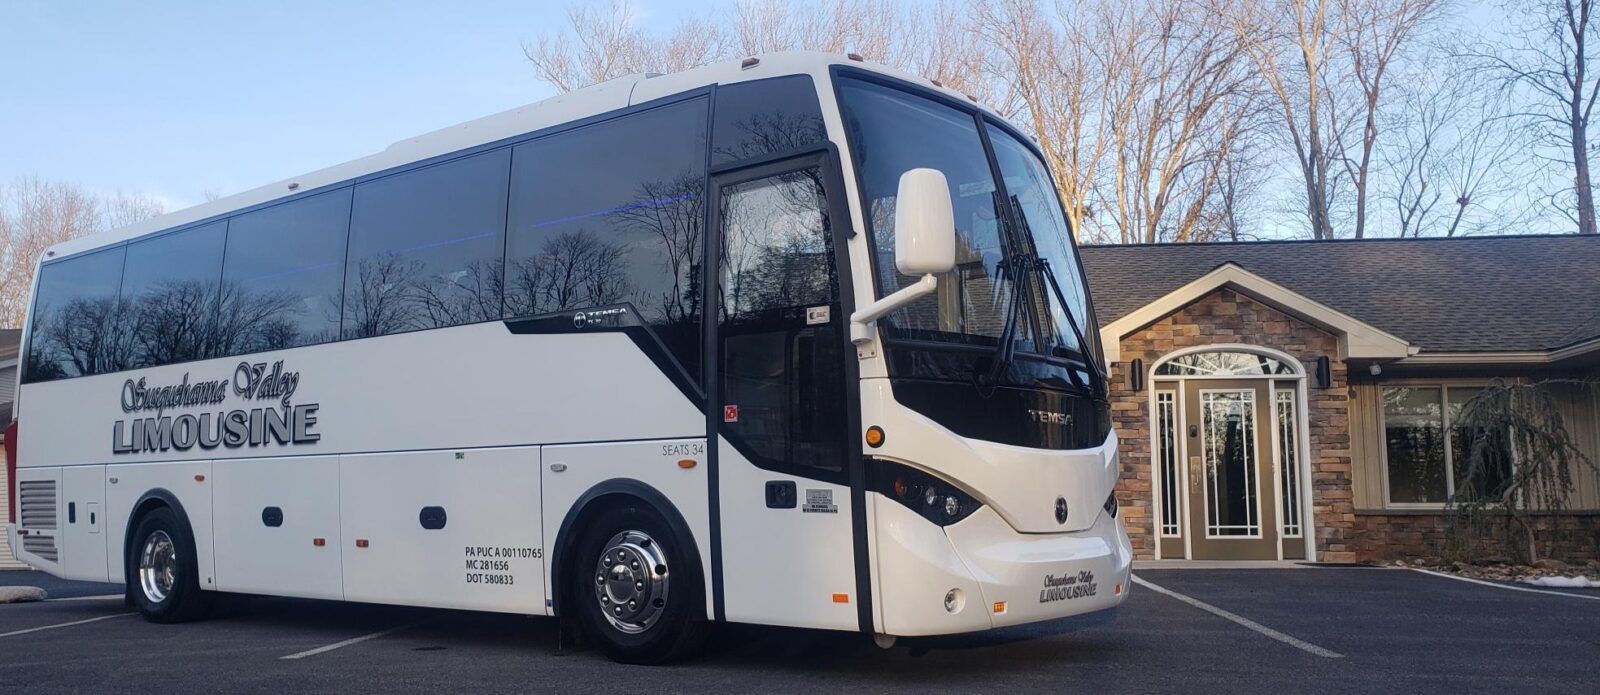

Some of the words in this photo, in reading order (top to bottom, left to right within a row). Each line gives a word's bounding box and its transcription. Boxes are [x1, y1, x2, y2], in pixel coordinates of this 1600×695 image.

[120, 372, 229, 418] Susquehanna
[233, 359, 300, 407] Valley
[1028, 409, 1073, 425] TEMSA
[112, 403, 321, 454] LIMOUSINE
[662, 444, 690, 456] SEATS
[692, 444, 704, 455] 34
[465, 546, 475, 557] PA
[477, 546, 493, 557] PUC
[494, 547, 500, 557] A
[502, 547, 542, 558] 00110765
[466, 560, 478, 570] MC
[480, 560, 509, 571] 281656
[466, 573, 482, 583] DOT
[485, 574, 514, 585] 580833
[1040, 583, 1097, 603] LIMOUSINE
